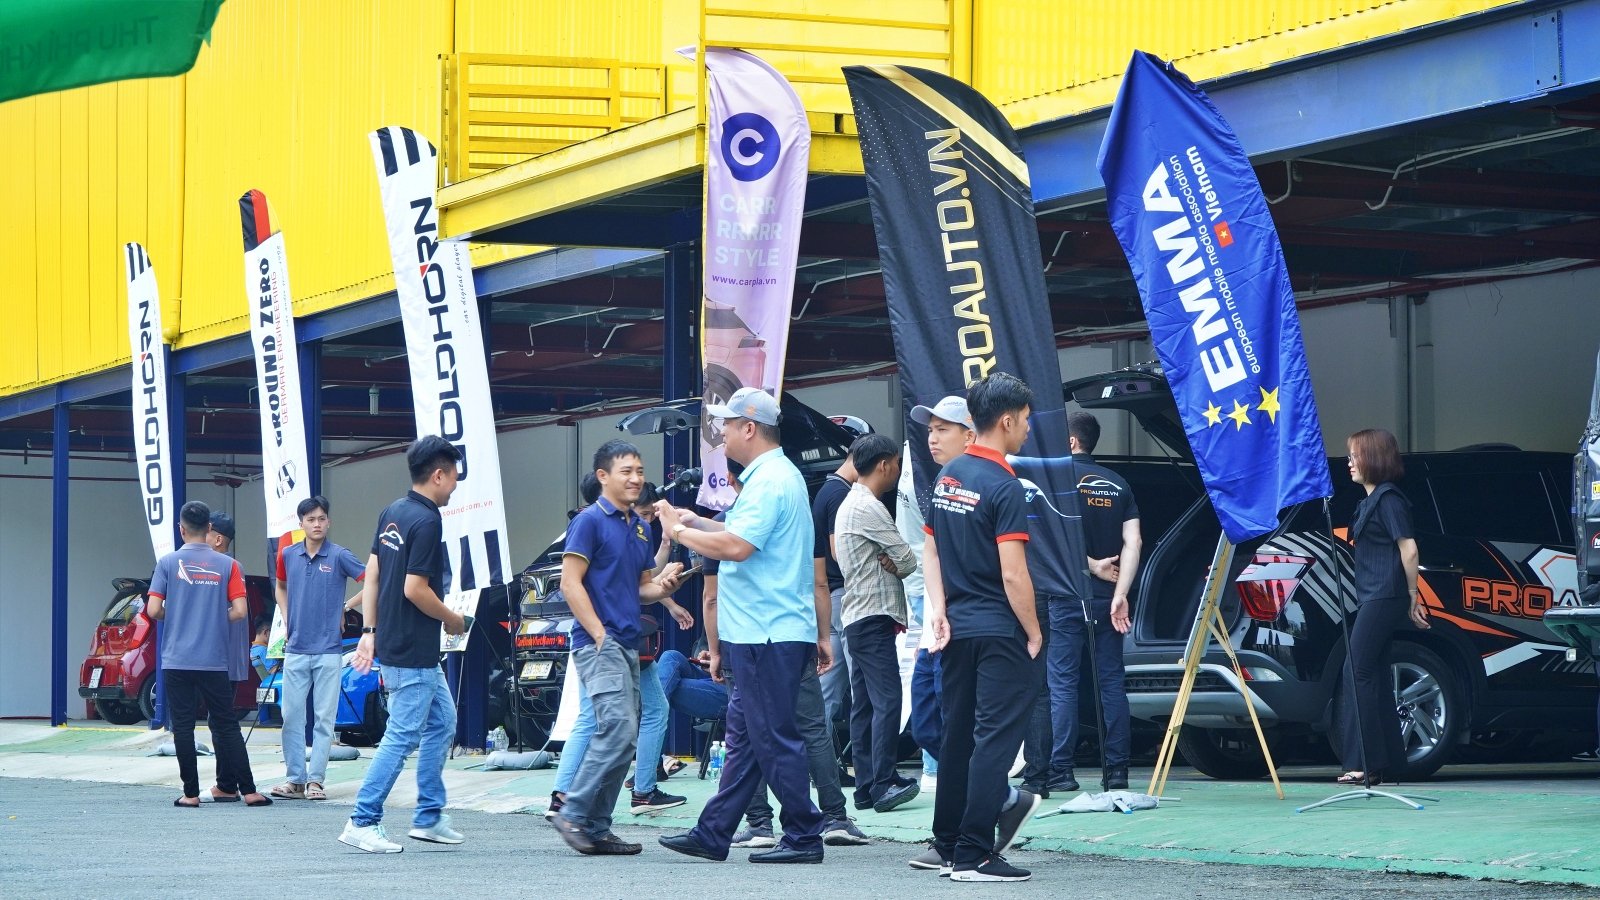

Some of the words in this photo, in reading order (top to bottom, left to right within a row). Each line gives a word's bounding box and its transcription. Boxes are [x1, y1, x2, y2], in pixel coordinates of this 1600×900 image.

[719, 193, 776, 214] CARR
[1169, 154, 1203, 223] association
[714, 246, 780, 267] STYLE
[925, 127, 998, 389] ROAUTO.VN
[1198, 224, 1219, 265] media
[259, 257, 275, 328] ZERO
[712, 275, 777, 287] www.carpla.vn
[1142, 161, 1248, 393] EMMA
[1214, 267, 1237, 310] mobile
[270, 271, 284, 361] ENGINEERING
[1231, 312, 1261, 375] european
[138, 300, 164, 526] GOLDHORN
[262, 334, 284, 448] GROUND
[279, 365, 290, 425] GERMAN
[1087, 497, 1112, 508] KCS
